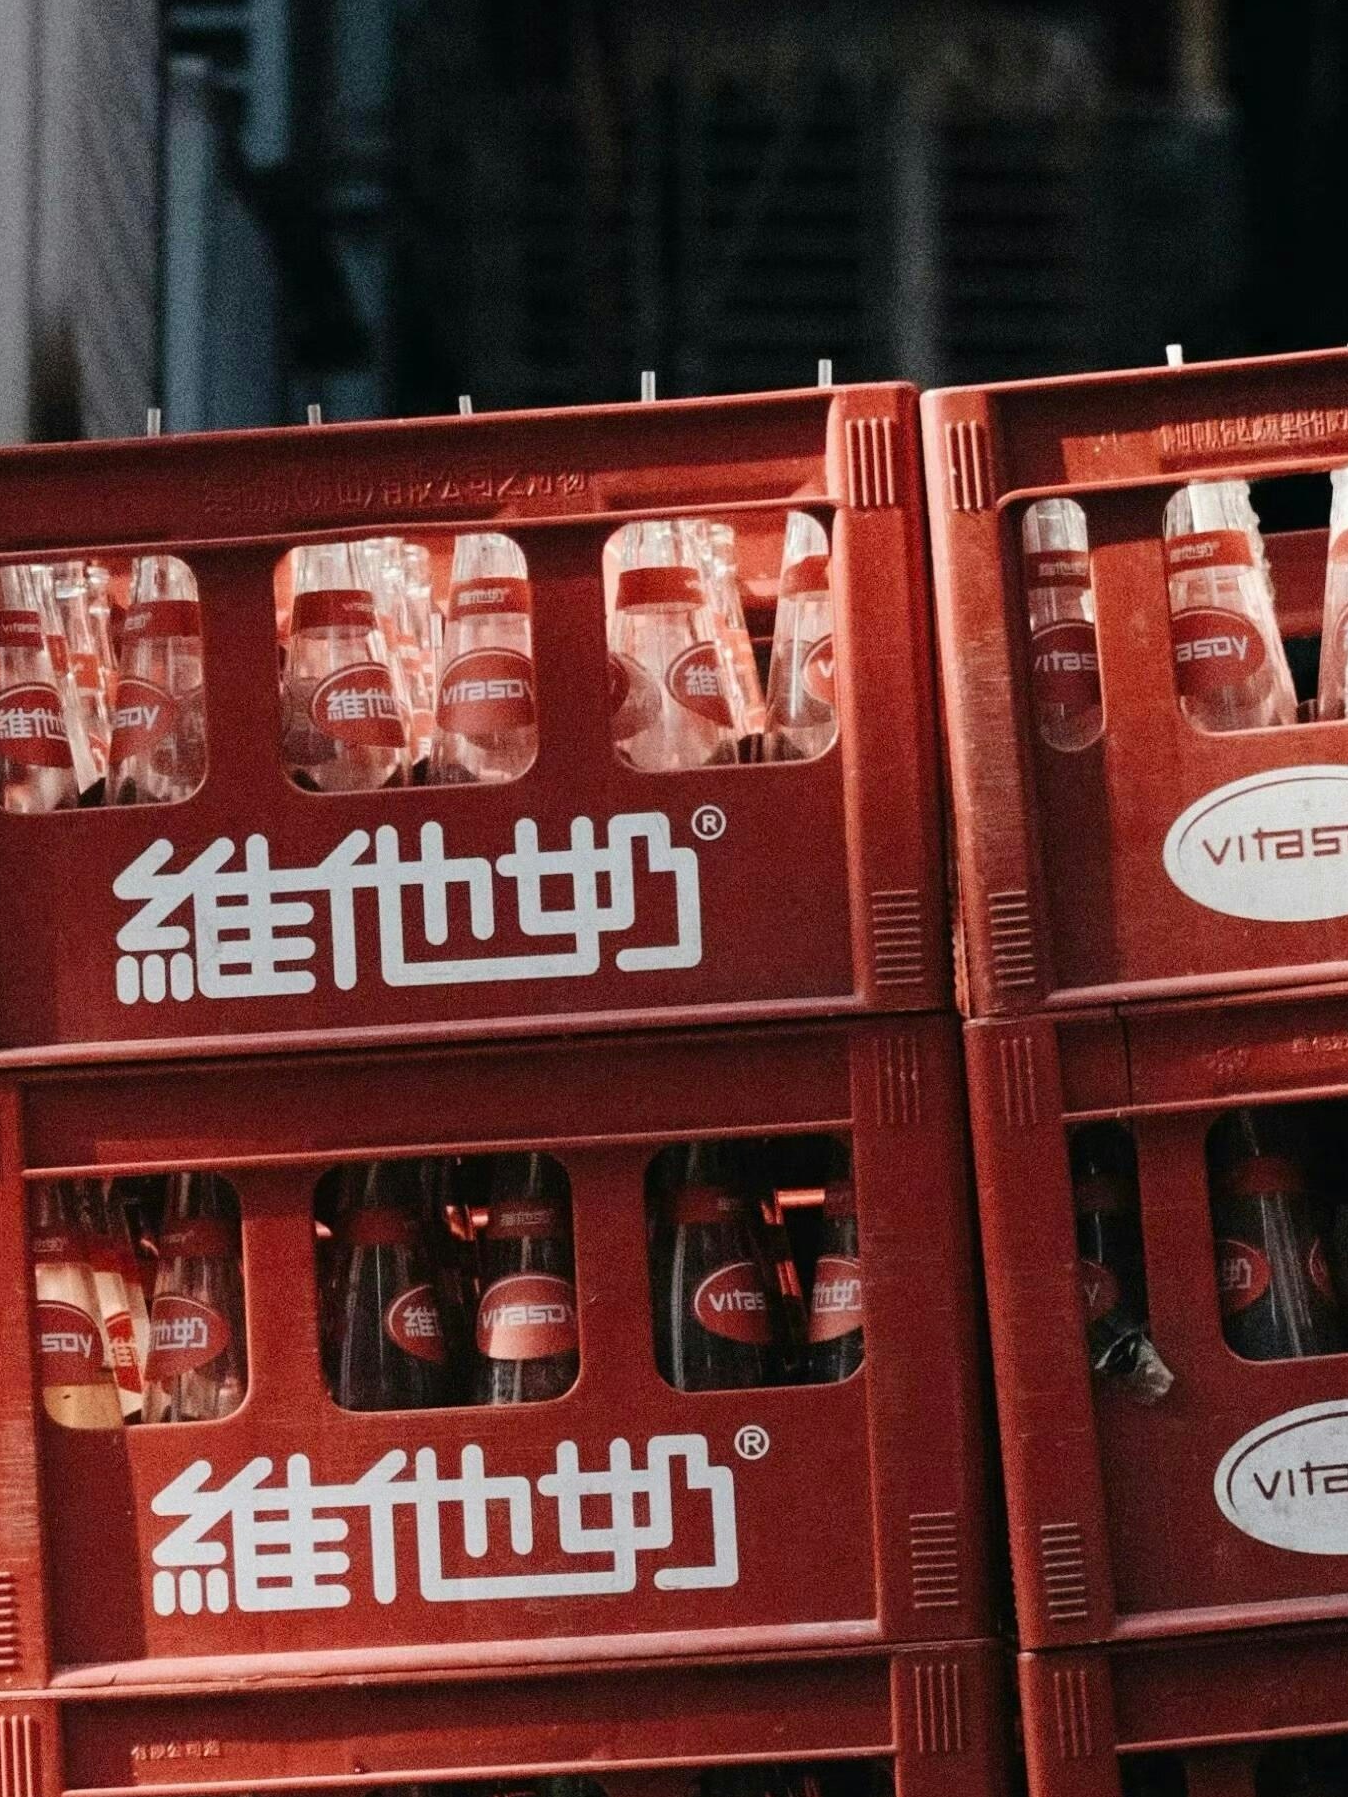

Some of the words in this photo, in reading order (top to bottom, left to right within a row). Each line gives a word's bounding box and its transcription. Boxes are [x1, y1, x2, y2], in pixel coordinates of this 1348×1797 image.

[326, 686, 406, 722] 維他
[113, 812, 703, 1004] 維他奶
[152, 1432, 740, 1616] 維他奶
